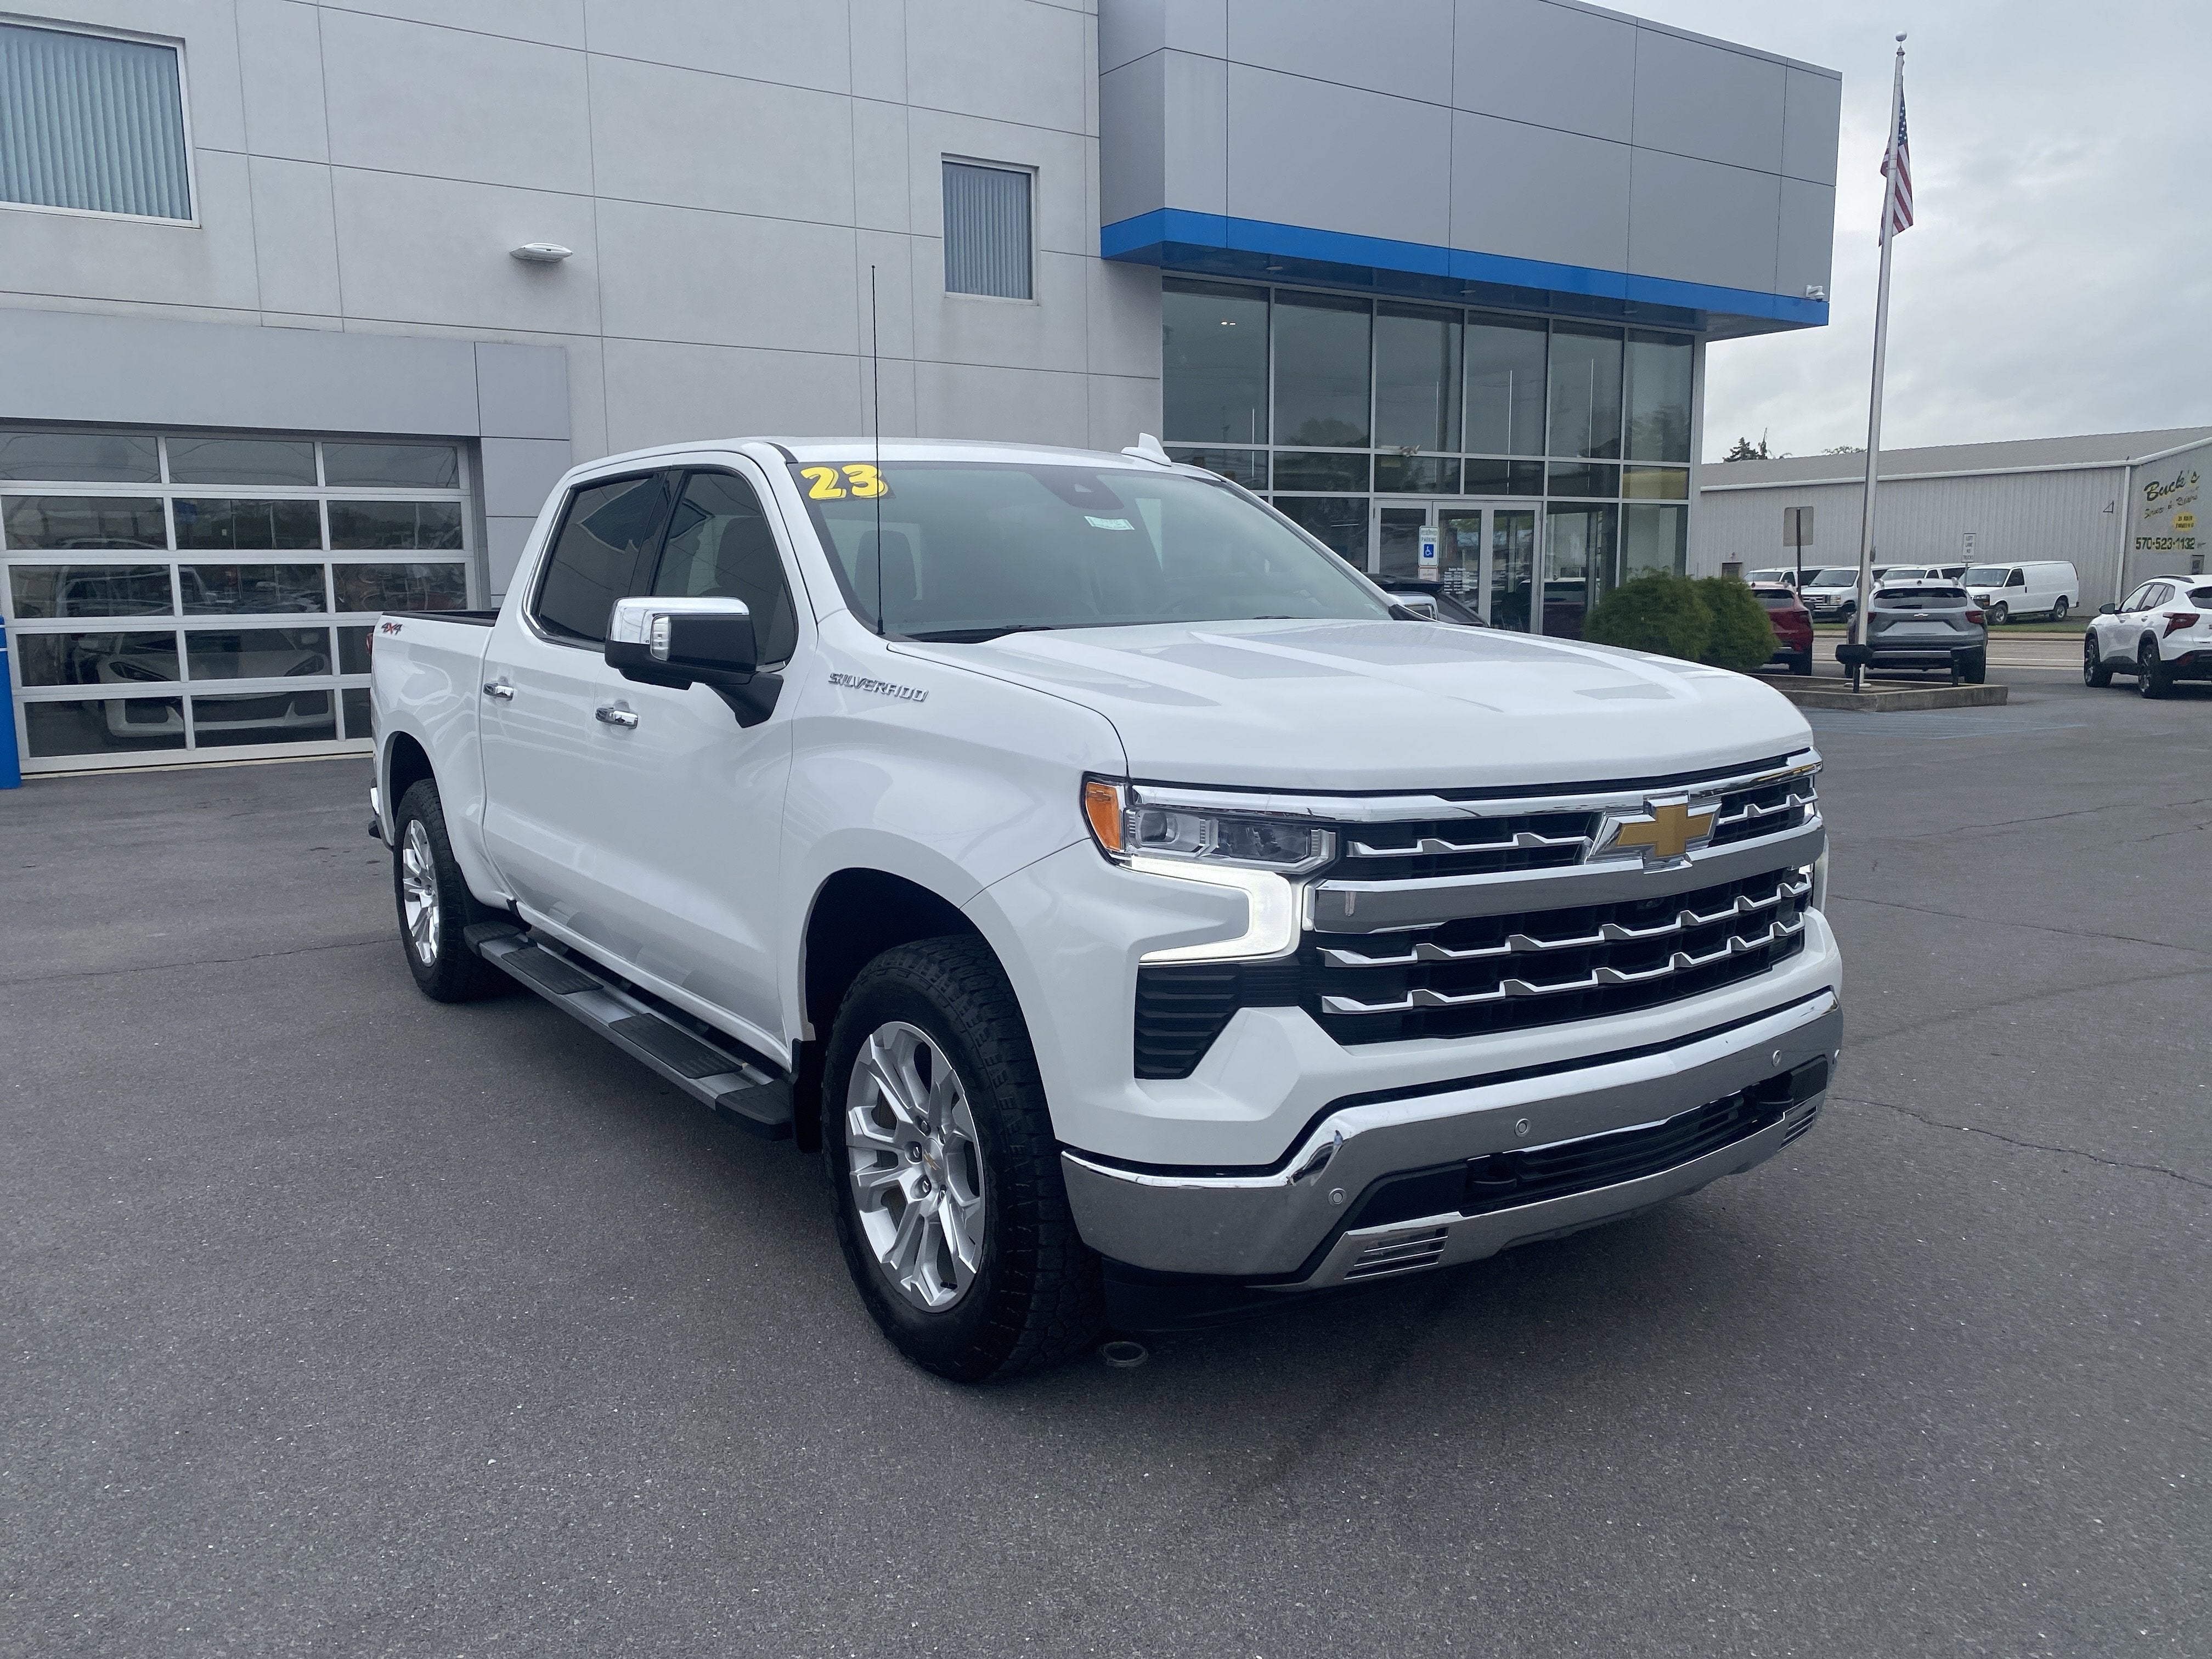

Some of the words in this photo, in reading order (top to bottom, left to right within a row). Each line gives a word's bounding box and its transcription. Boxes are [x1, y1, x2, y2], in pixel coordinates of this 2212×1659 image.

[800, 464, 889, 500] 23
[2143, 470, 2200, 501] Buck's
[828, 672, 929, 702] SILVERADO
